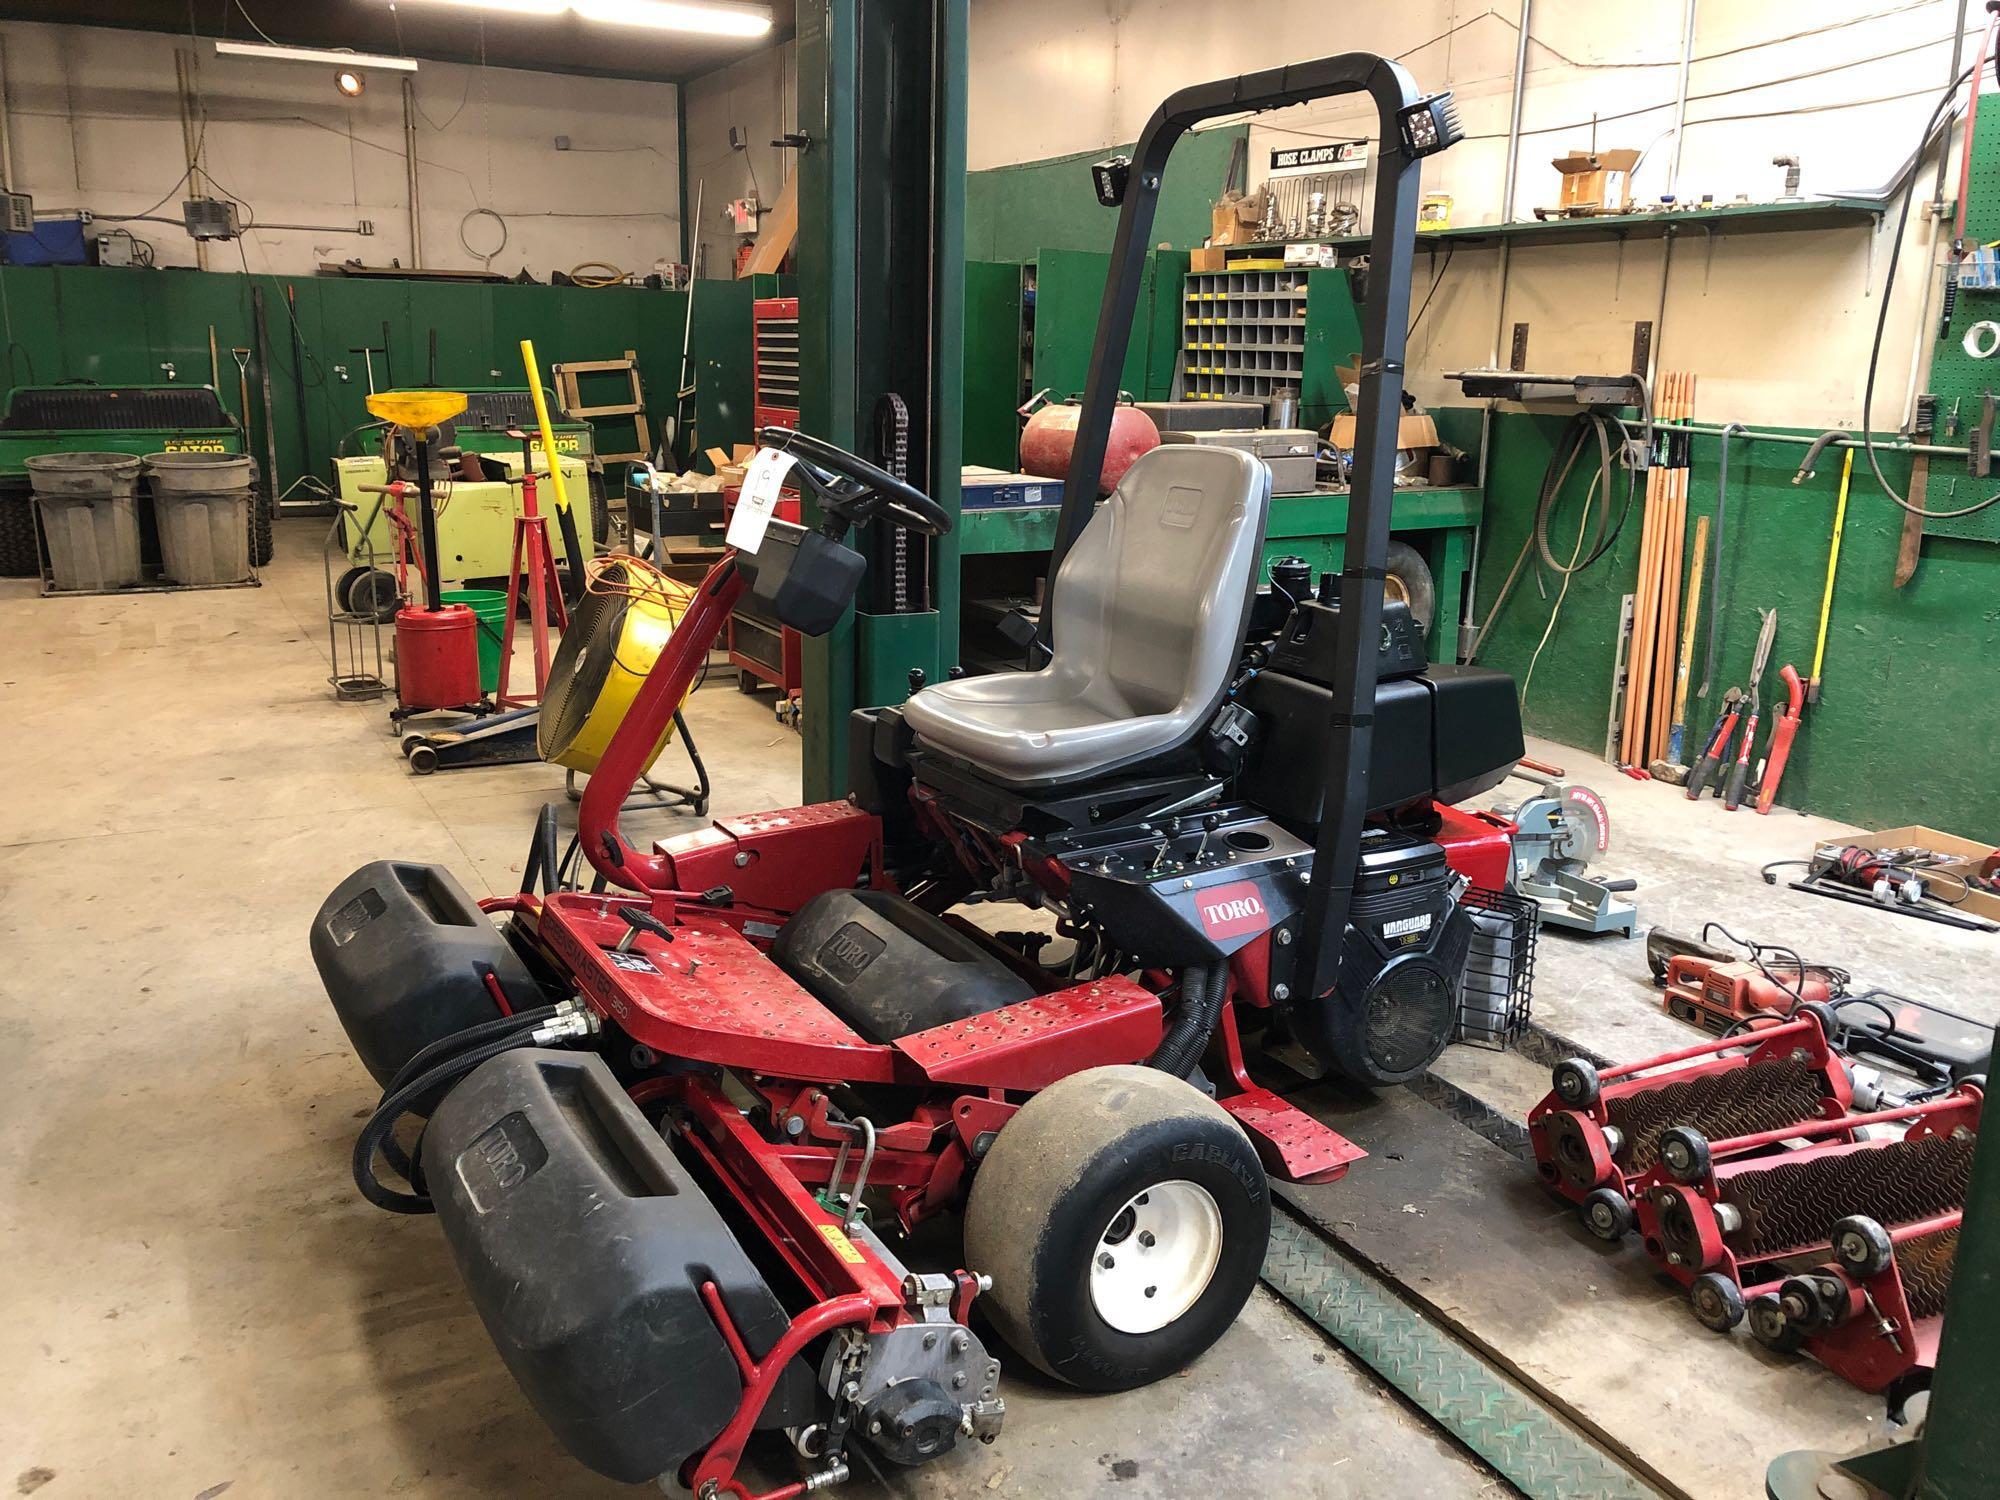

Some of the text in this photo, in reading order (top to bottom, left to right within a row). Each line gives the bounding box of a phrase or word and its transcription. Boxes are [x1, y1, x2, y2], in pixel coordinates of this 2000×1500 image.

[1277, 151, 1298, 167] HOSE
[1299, 147, 1334, 164] CLAMPS
[1203, 897, 1261, 924] TORO
[1383, 913, 1432, 936] VANGUARD
[829, 933, 870, 969] TORO
[479, 1127, 526, 1188] TORO
